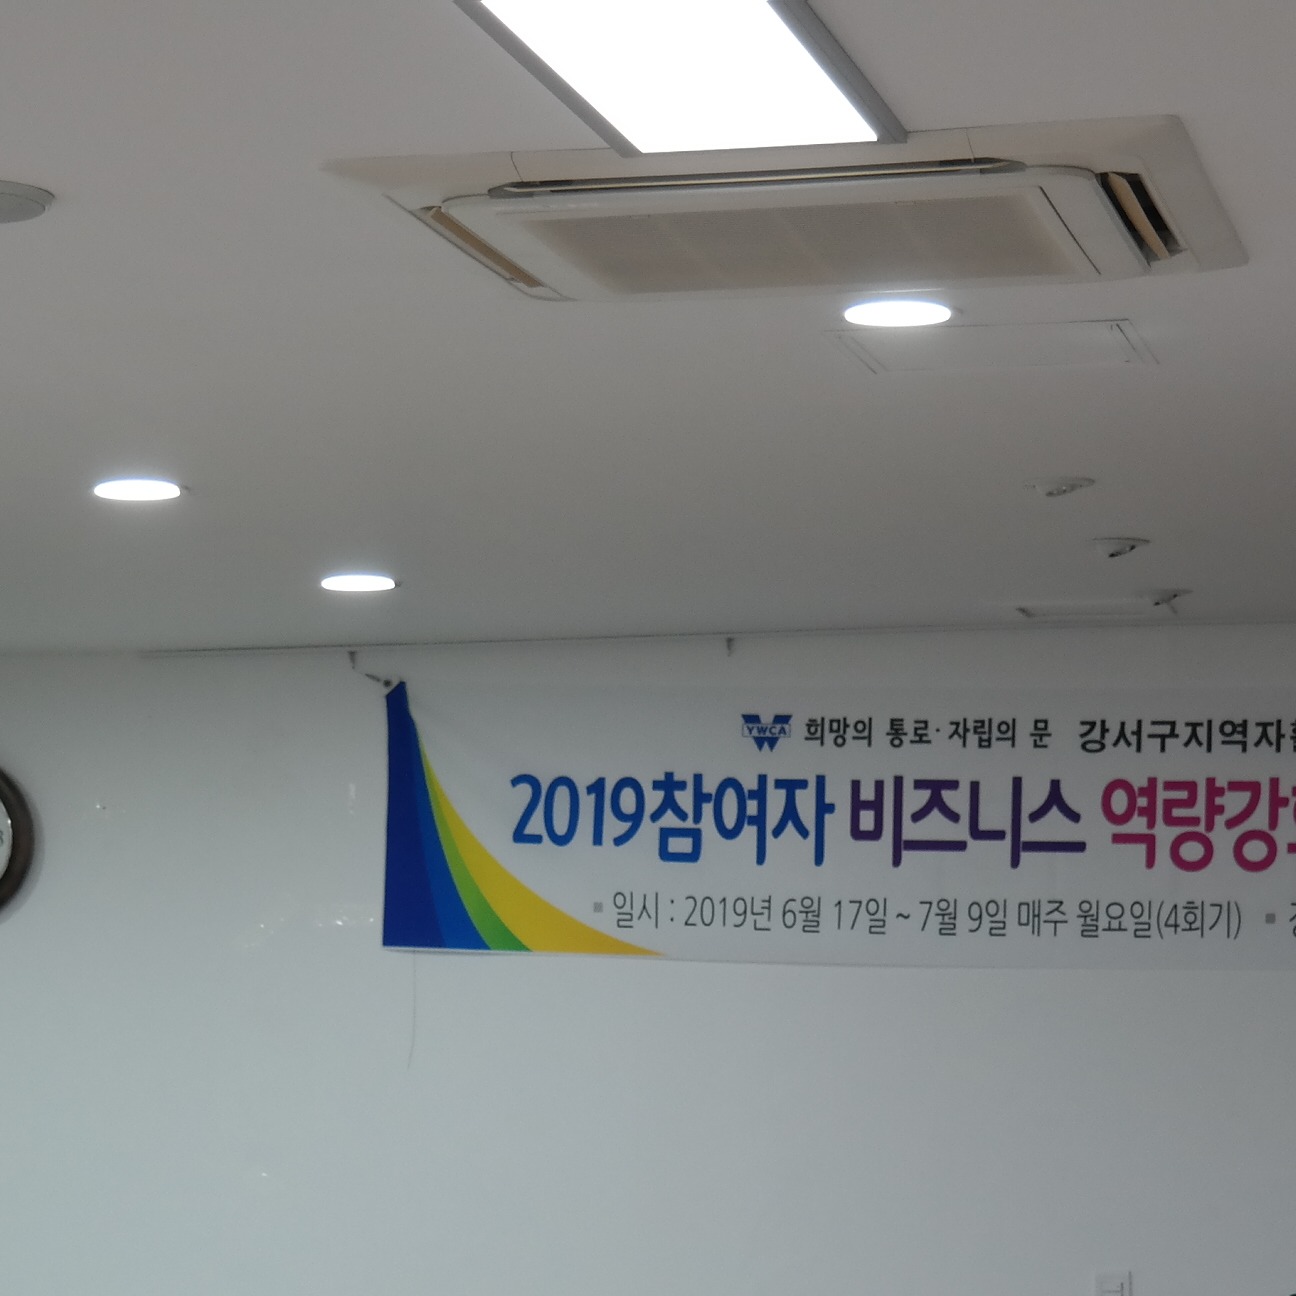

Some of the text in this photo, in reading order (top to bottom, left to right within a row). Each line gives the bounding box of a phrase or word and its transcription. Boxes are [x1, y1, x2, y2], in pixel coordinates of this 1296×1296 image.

[746, 725, 787, 736] YWCA
[804, 716, 873, 749] 희망의
[1030, 718, 1053, 749] 문
[509, 771, 836, 867] 2019참여자
[849, 774, 1088, 870] 비즈니스
[612, 891, 660, 930] 일시
[683, 894, 772, 932] 2019년
[781, 896, 822, 934] 6월
[834, 897, 888, 936] 17일
[918, 897, 958, 937] 7월
[967, 898, 1008, 937] 9일
[1017, 898, 1069, 938] 매주
[1076, 899, 1242, 940] 월요일(4회기)
